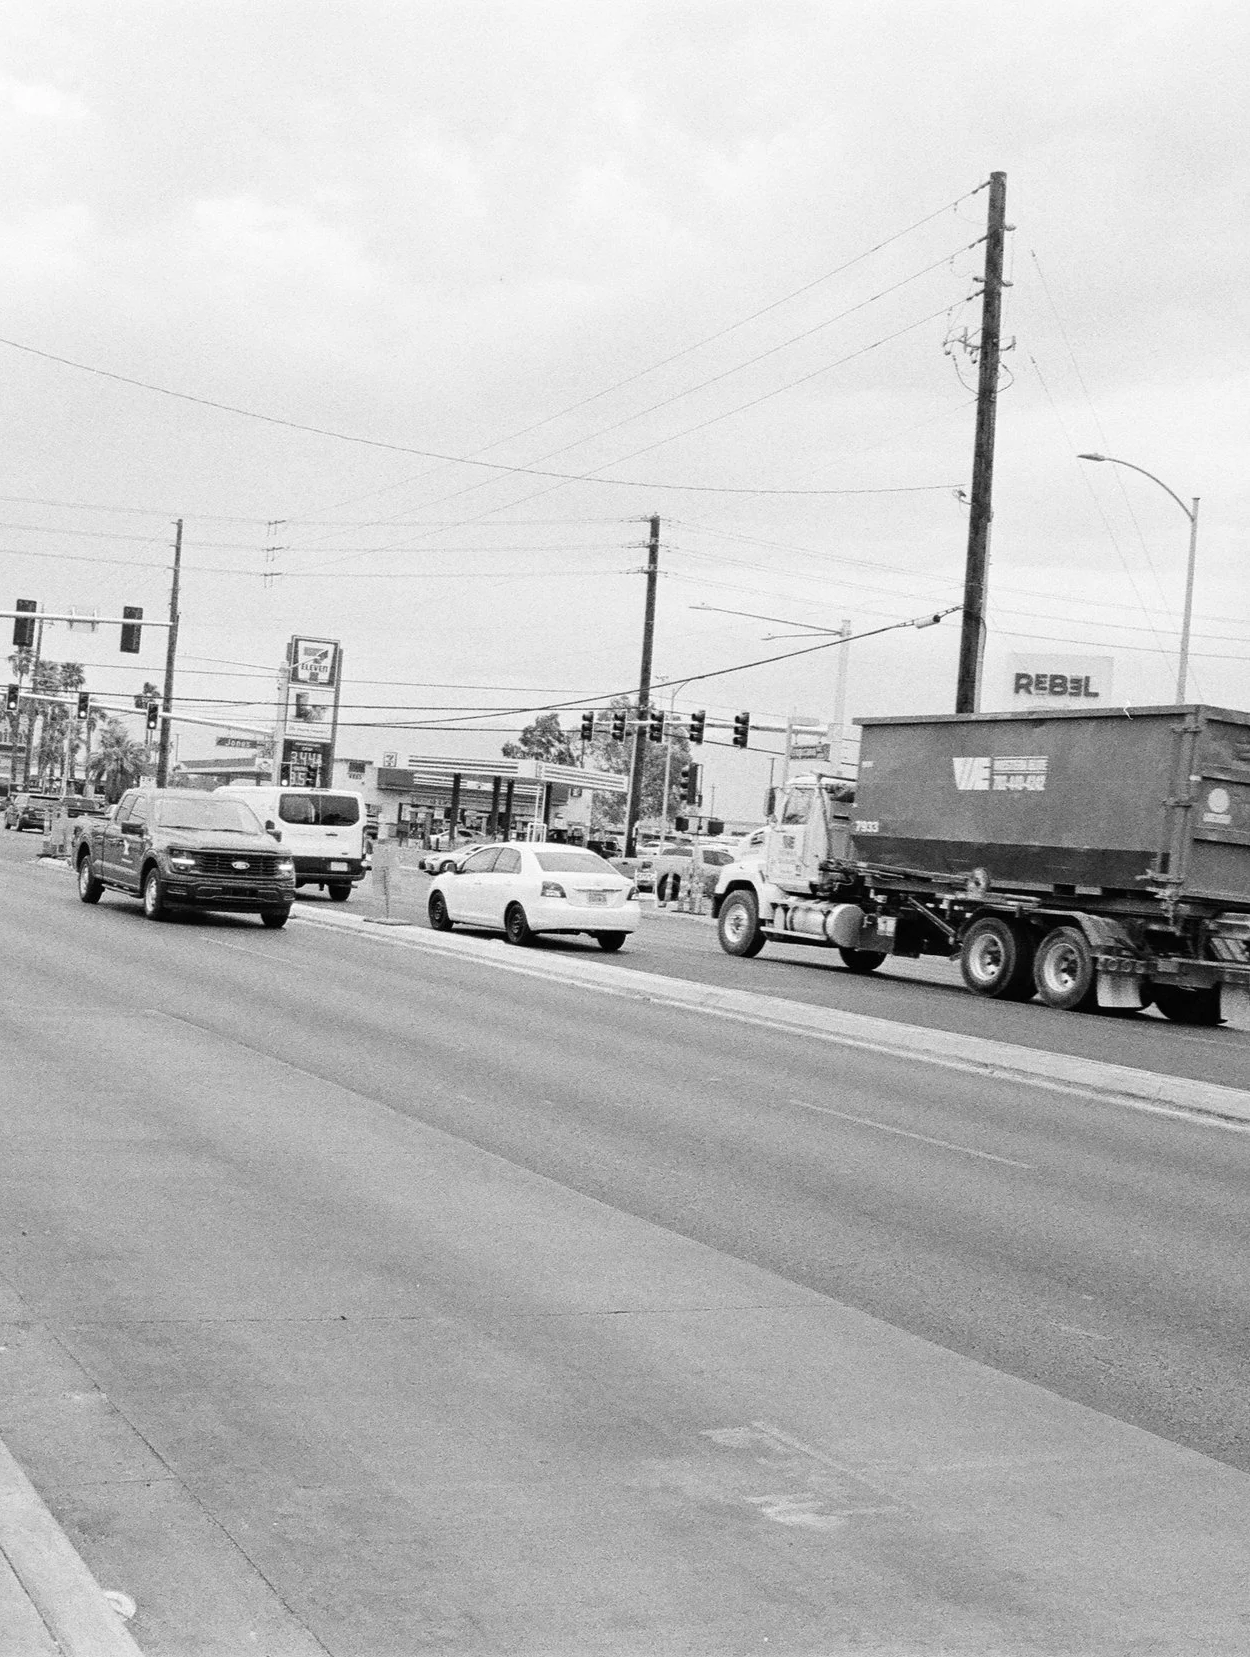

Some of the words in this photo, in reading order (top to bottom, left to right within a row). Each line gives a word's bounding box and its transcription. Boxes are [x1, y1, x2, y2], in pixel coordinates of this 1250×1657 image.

[1014, 672, 1099, 697] REBEL
[225, 739, 251, 748] Jones
[855, 820, 879, 833] 7933
